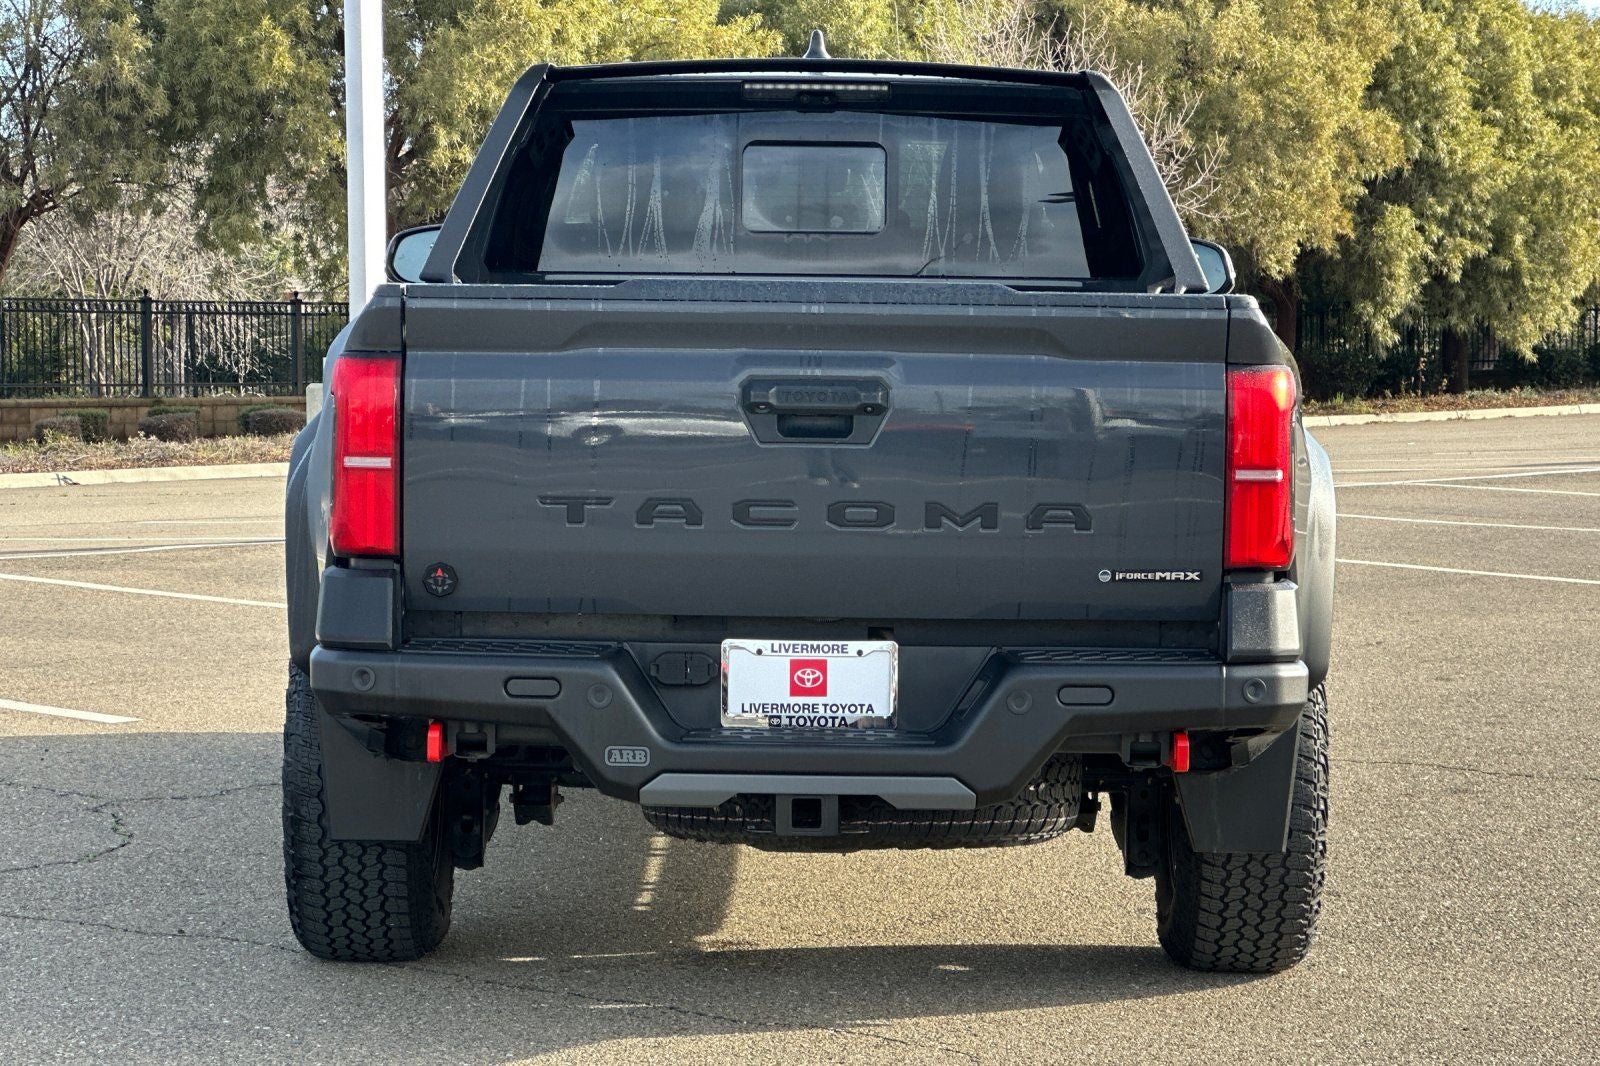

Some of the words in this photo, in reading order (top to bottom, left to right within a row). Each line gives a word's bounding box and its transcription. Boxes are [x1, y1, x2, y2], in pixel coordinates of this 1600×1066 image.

[782, 391, 848, 402] TOYOTA
[537, 496, 1094, 533] TACOMA
[770, 642, 849, 654] LIVERMORE
[741, 703, 820, 714] LIVERMORE
[822, 703, 875, 714] TOYOTA
[786, 715, 849, 728] TOYOTA
[609, 749, 646, 763] ARB
